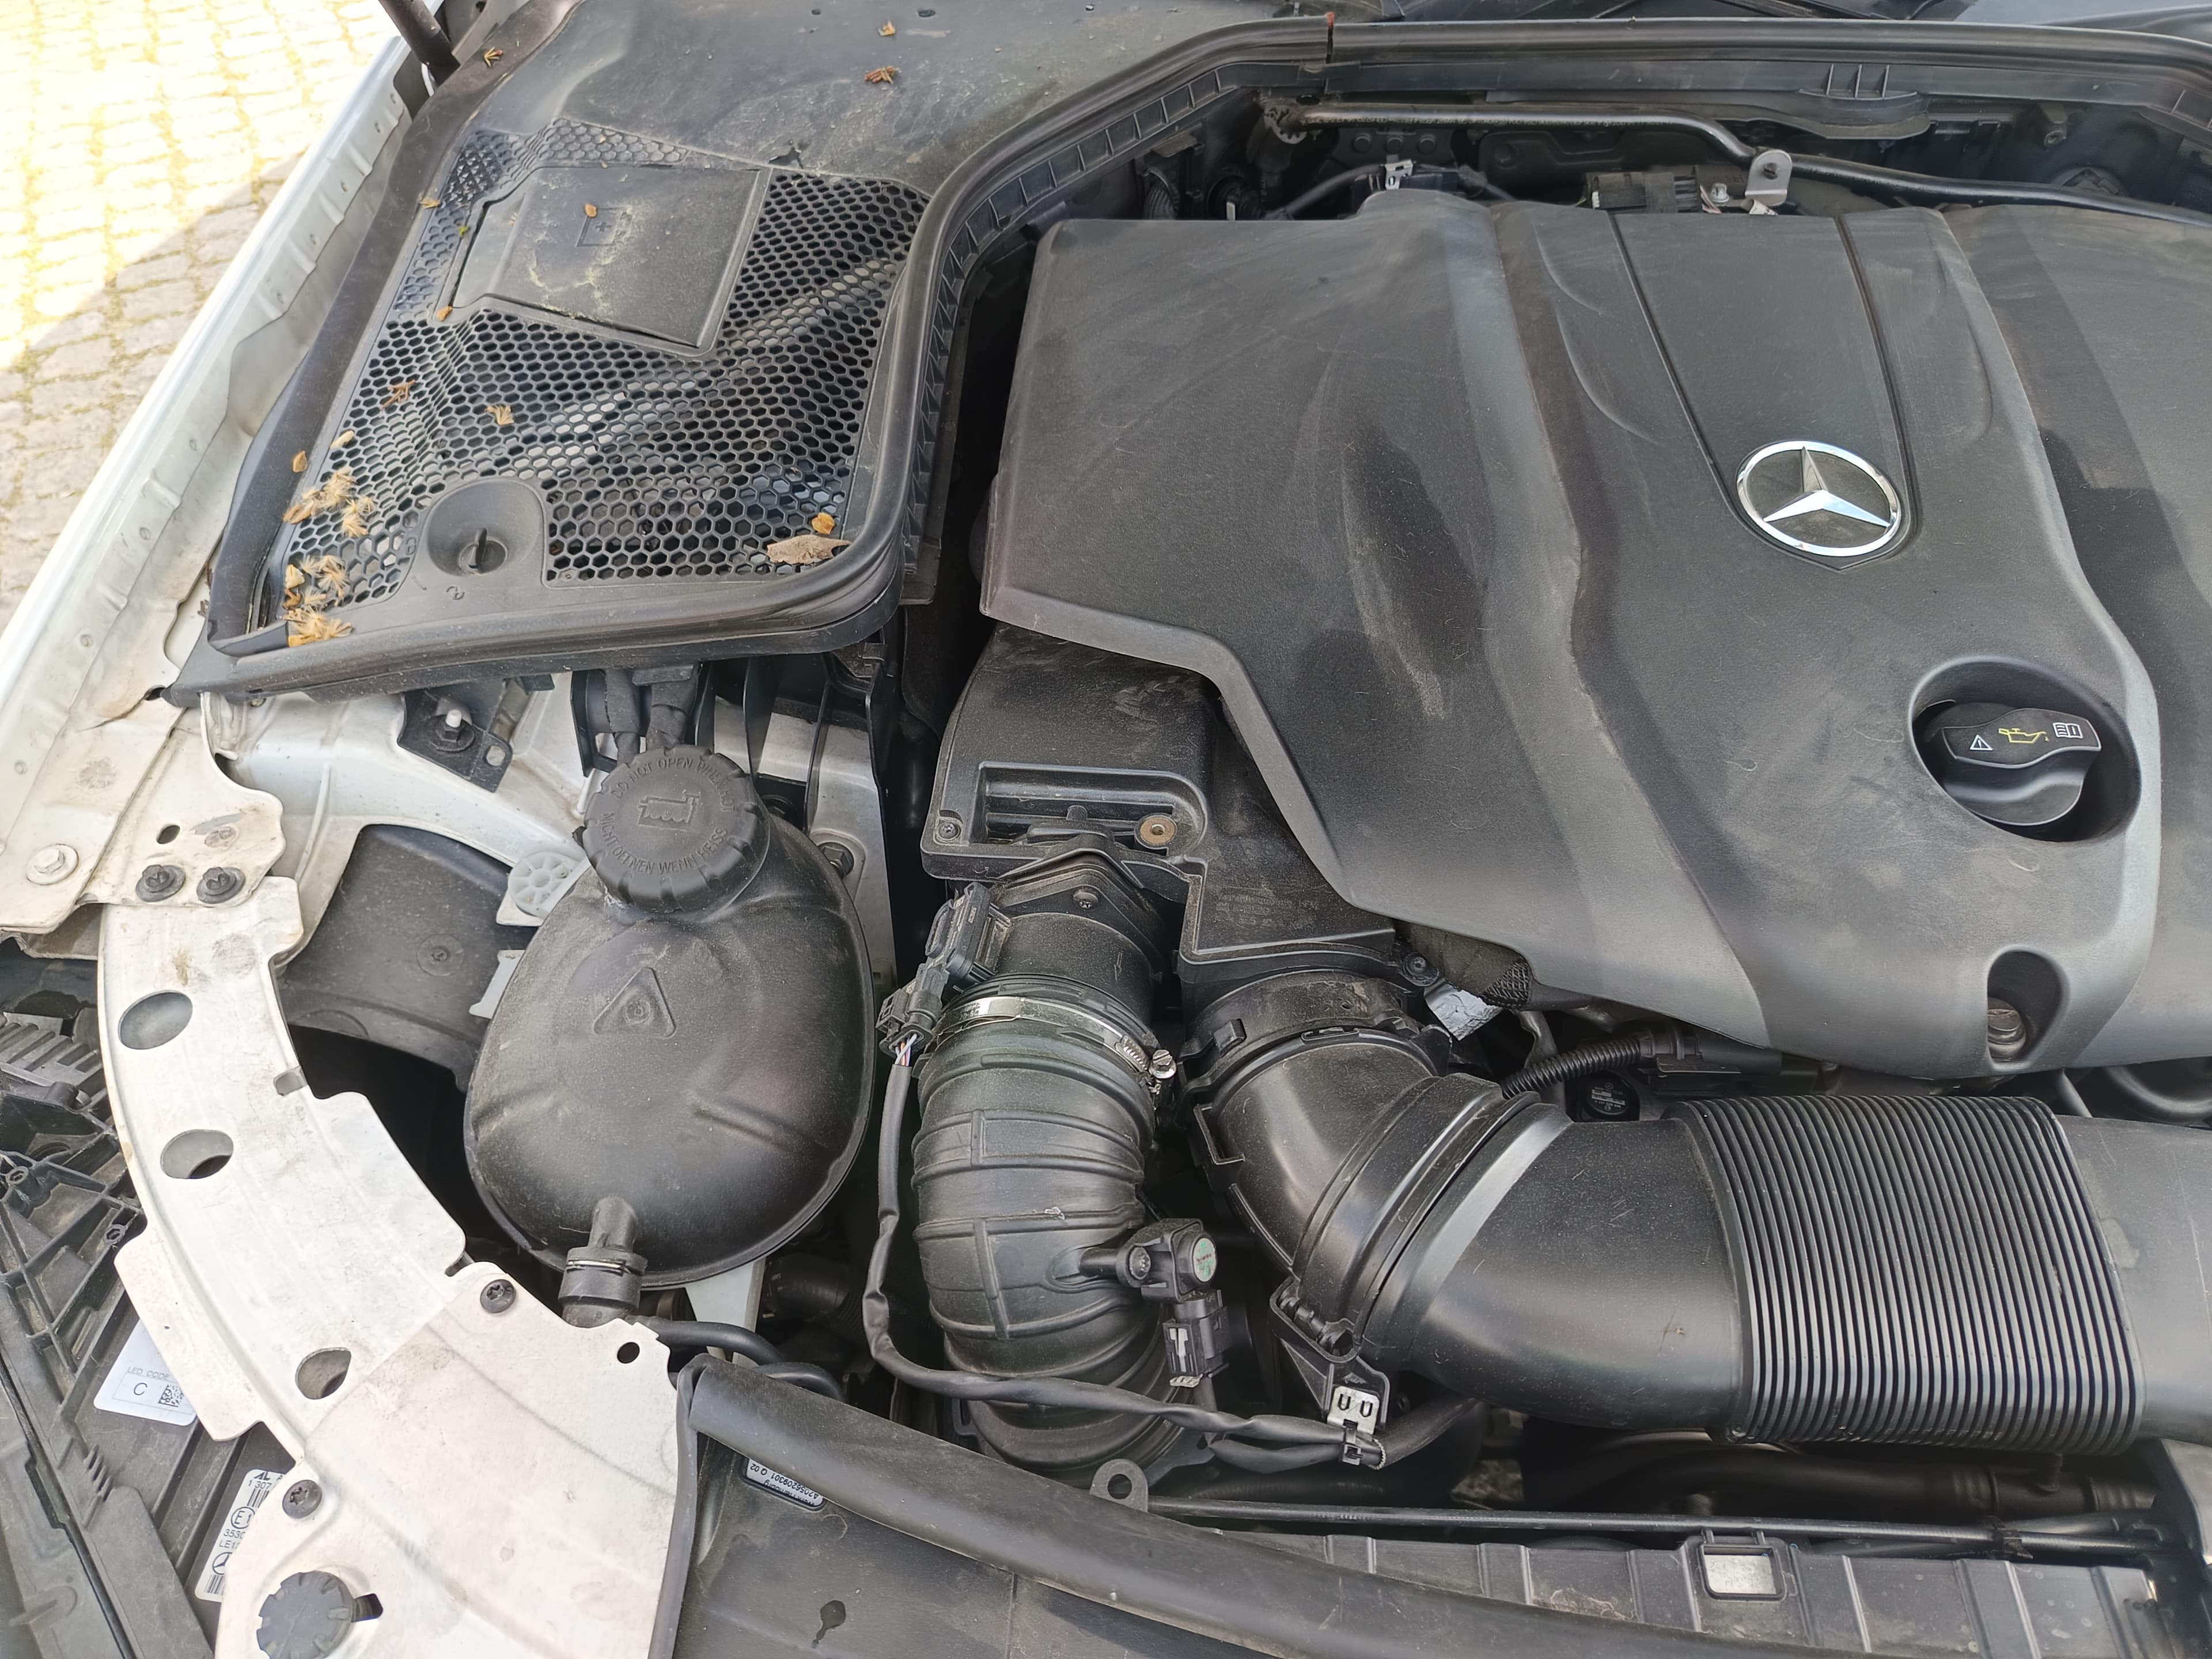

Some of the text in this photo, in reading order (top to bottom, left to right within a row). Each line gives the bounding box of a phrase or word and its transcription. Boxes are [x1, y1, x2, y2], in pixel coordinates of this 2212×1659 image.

[611, 782, 629, 798] DO
[630, 762, 653, 783] NOT
[657, 758, 694, 770] OPEN
[696, 761, 728, 790] WHEN
[600, 812, 620, 847] NICHT
[659, 854, 698, 875] WENN
[696, 827, 729, 859] HEISS
[127, 1366, 171, 1381] LED CODE
[133, 1382, 148, 1396] C
[750, 1463, 820, 1499] A2056209301 Q 02
